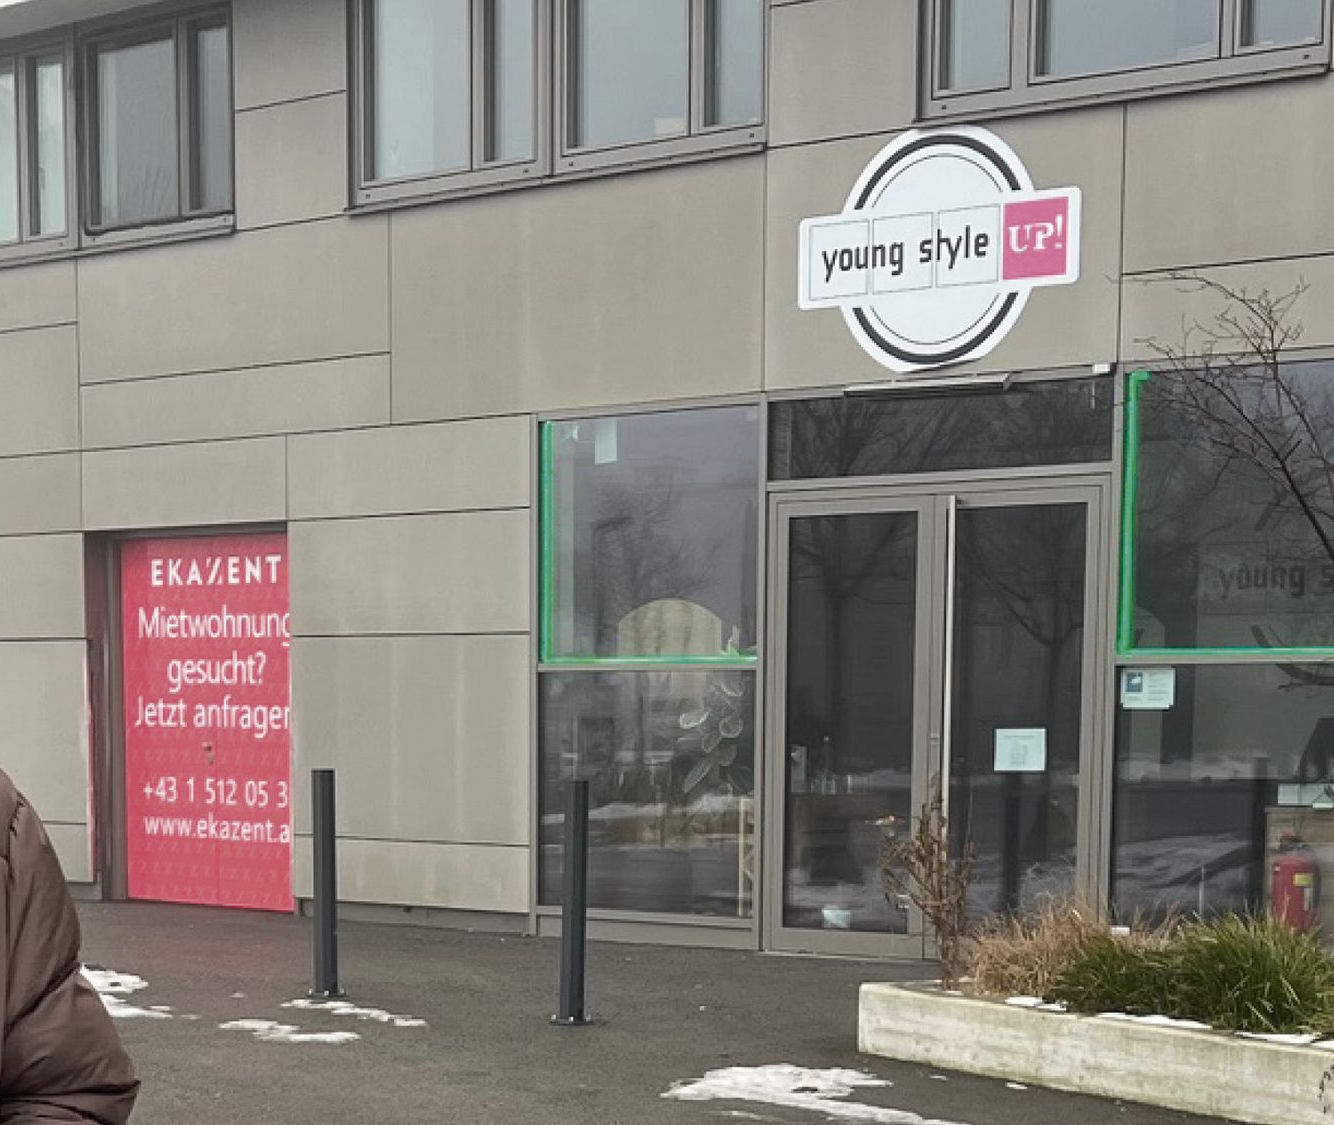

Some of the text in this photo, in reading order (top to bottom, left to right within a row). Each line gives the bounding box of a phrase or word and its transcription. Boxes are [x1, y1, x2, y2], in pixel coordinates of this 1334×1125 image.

[821, 213, 1063, 283] young style UP!
[167, 651, 267, 693] gesucht?
[134, 696, 187, 728] Jetzt
[142, 776, 178, 803] +43
[186, 777, 195, 802] 1
[204, 778, 237, 806] 512
[244, 780, 269, 808] 05
